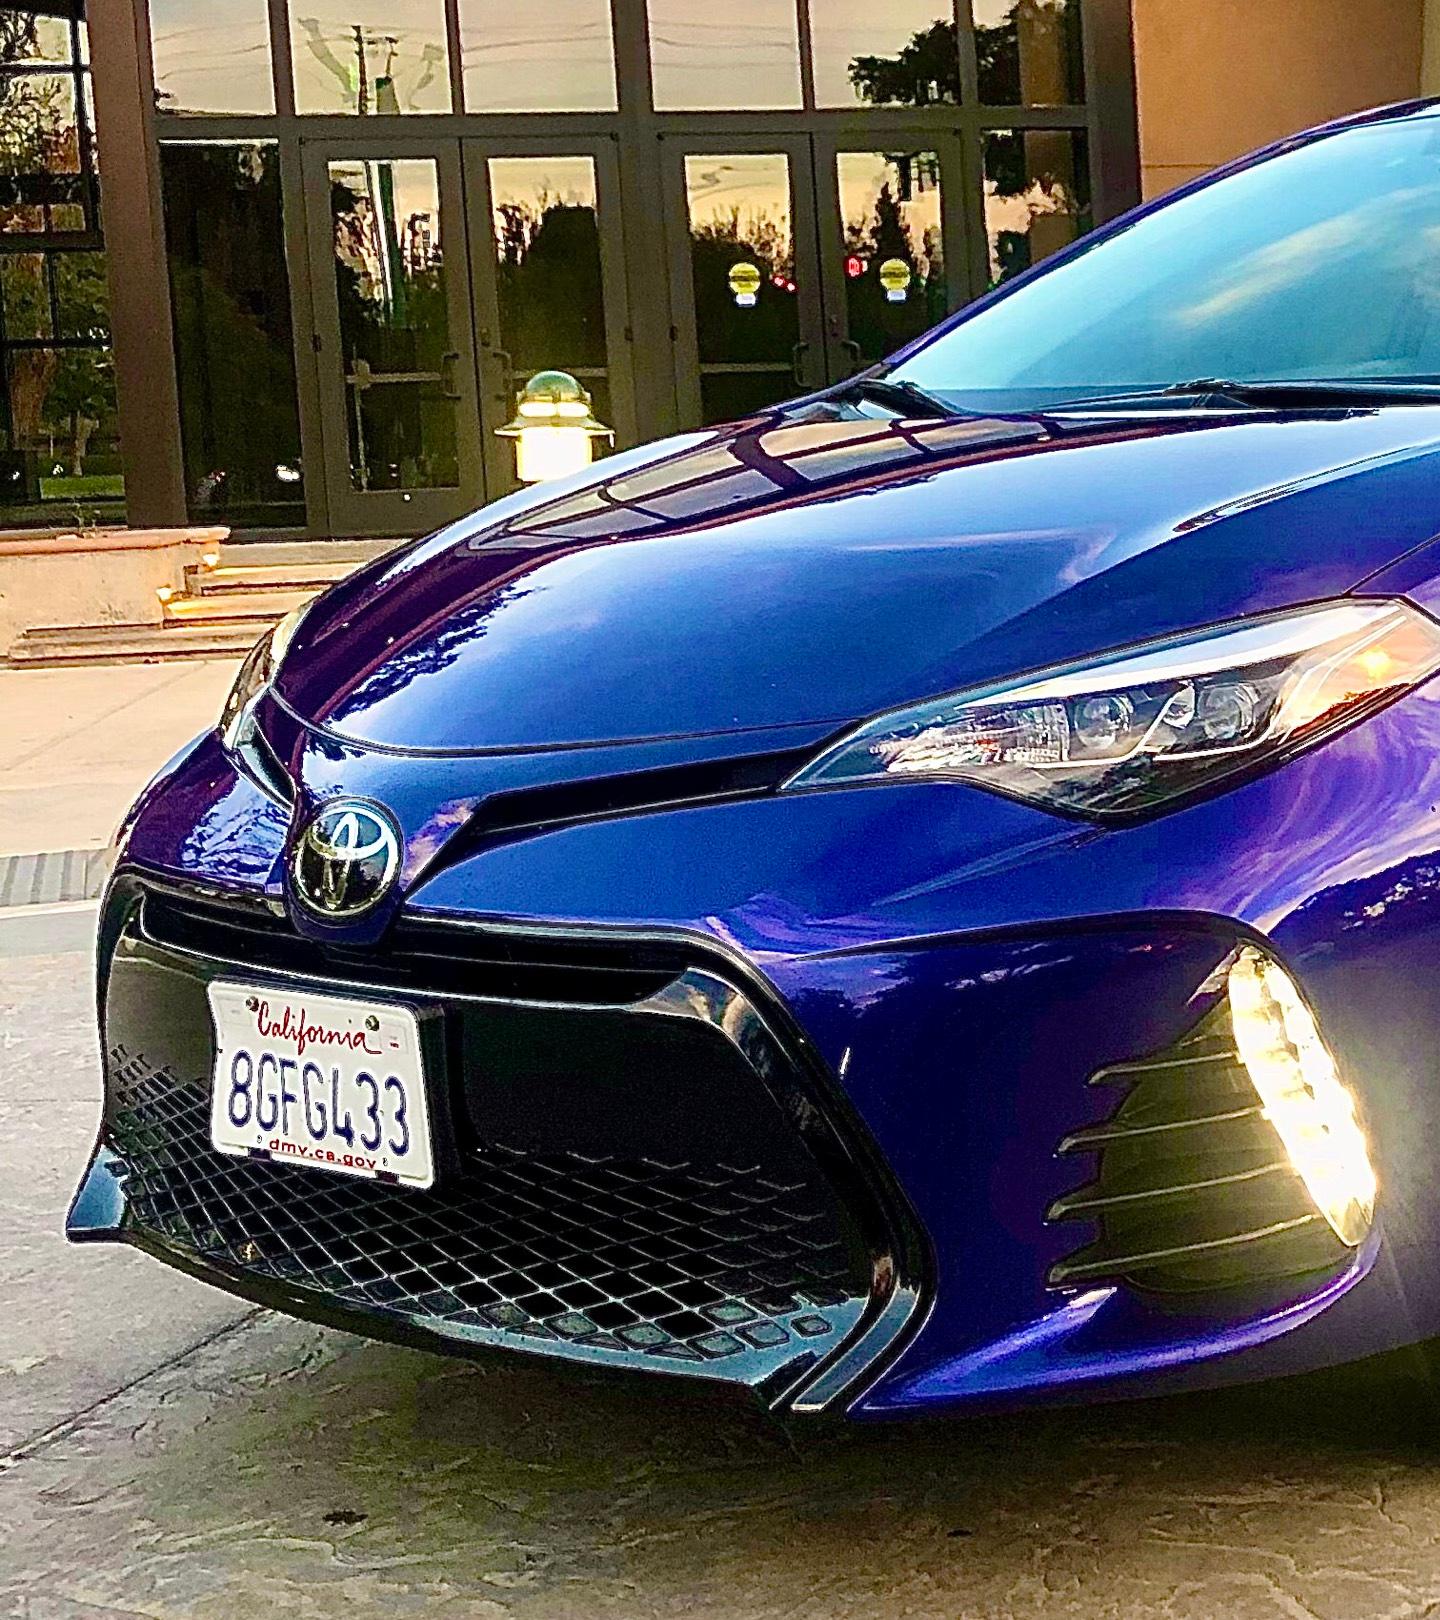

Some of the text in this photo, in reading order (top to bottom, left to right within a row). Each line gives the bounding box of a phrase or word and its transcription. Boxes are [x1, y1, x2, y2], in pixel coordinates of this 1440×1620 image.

[257, 1001, 382, 1056] California
[228, 1050, 410, 1157] 8GFG433
[268, 1138, 377, 1169] dmv.ca.gov
